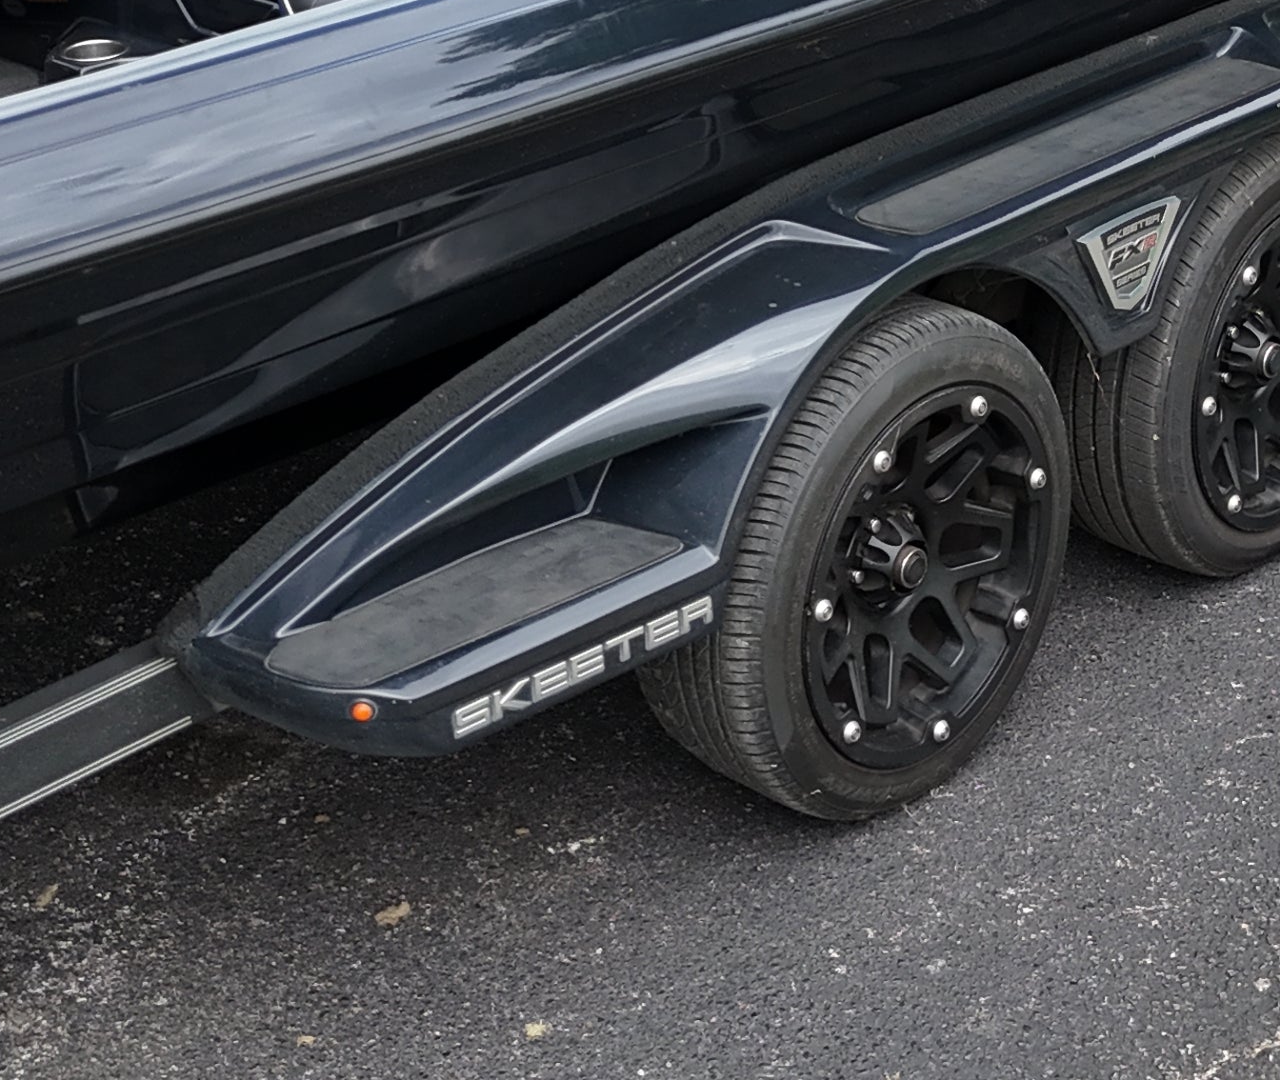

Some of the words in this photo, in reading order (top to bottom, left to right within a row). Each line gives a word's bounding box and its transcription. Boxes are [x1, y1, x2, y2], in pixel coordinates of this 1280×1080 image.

[1107, 212, 1161, 247] SKEETER
[1108, 230, 1158, 271] FXR
[451, 595, 714, 740] SKEETER
